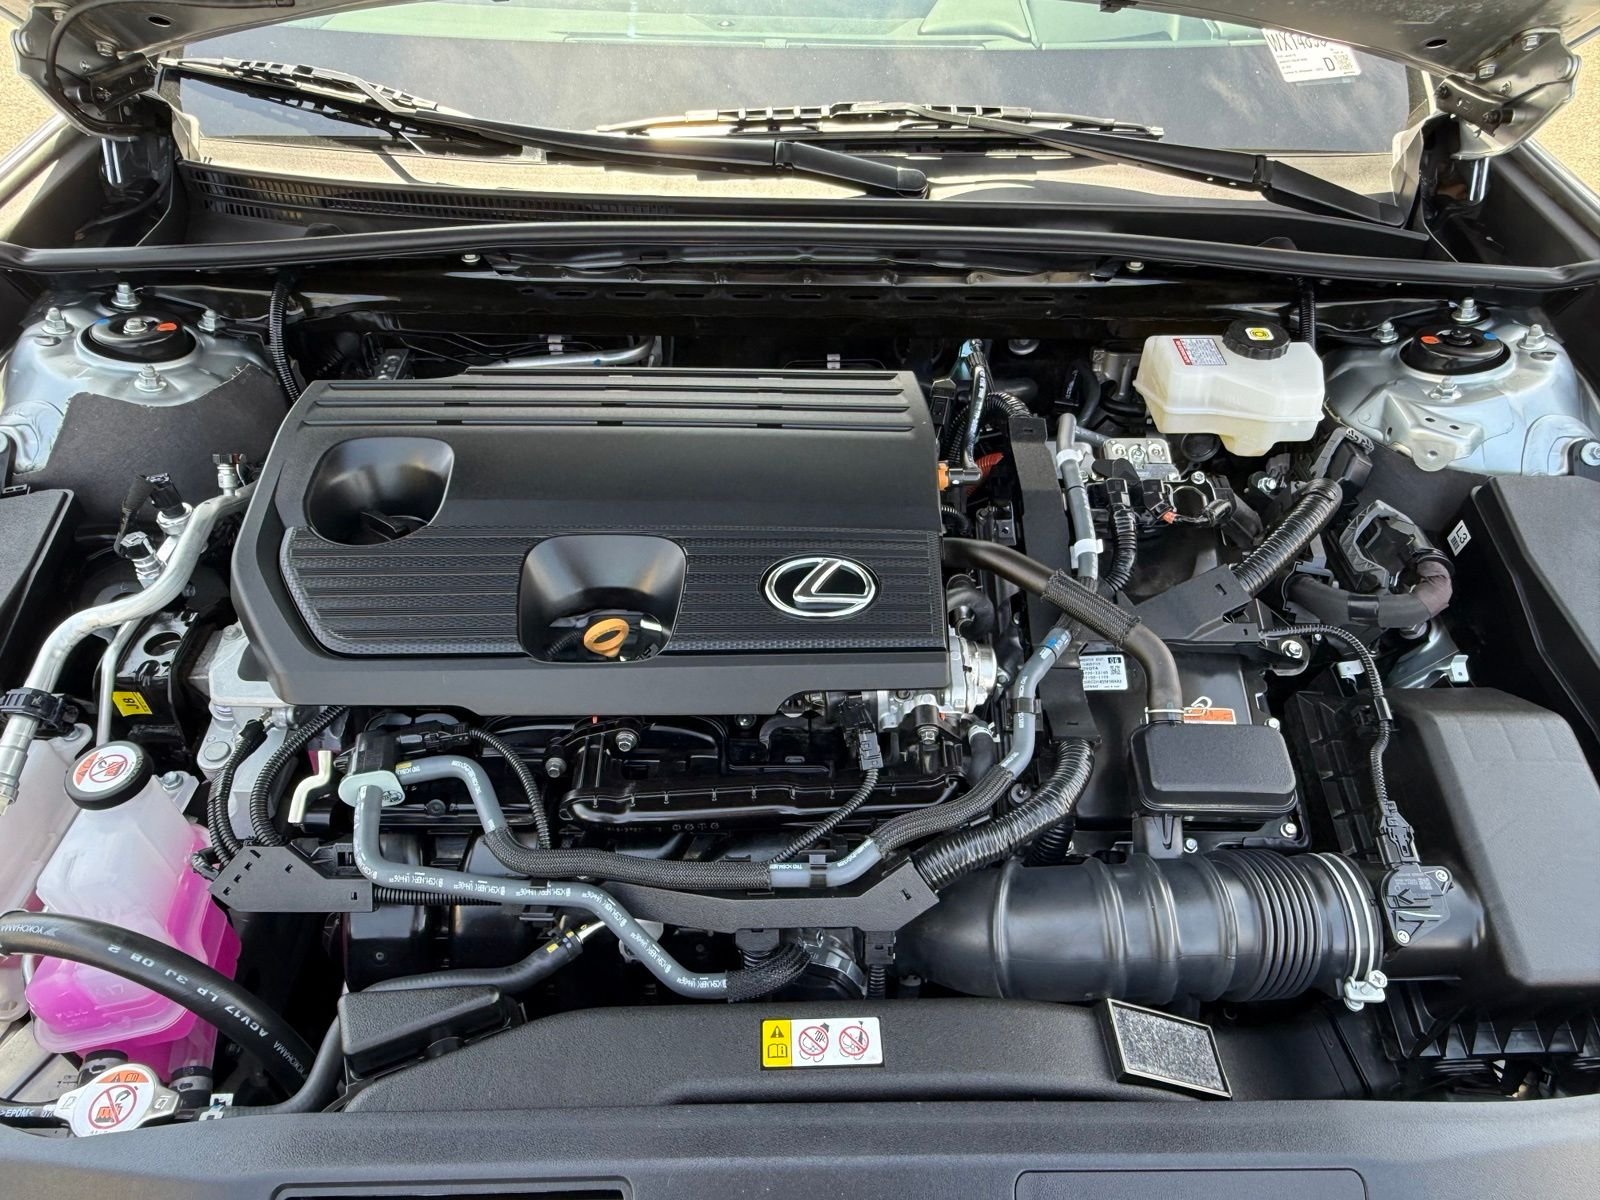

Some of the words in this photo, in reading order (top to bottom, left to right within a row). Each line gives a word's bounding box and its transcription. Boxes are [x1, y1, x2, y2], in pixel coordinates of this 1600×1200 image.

[1323, 57, 1336, 71] D
[1456, 525, 1468, 544] L3
[107, 943, 121, 954] 2
[164, 968, 189, 985] 3J
[196, 987, 219, 1002] LP
[224, 1005, 269, 1037] ACV17
